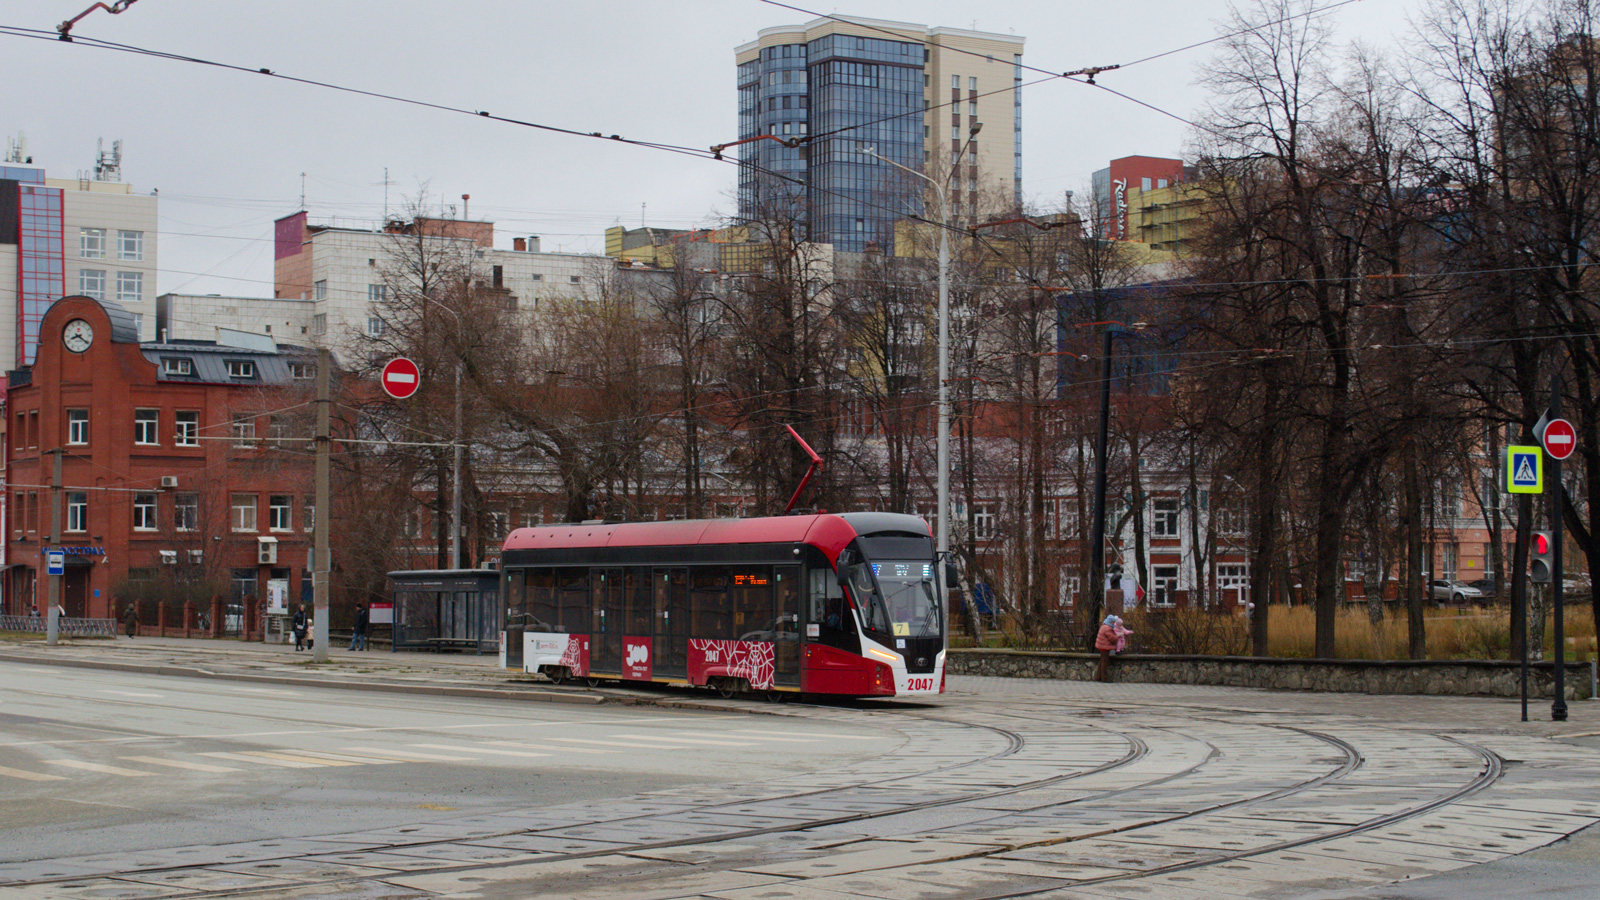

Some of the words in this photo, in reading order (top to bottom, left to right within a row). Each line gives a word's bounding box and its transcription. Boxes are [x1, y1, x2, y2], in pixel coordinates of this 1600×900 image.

[41, 546, 106, 555] ИОССТРАХ
[896, 624, 904, 634] 7
[626, 644, 648, 666] 300
[705, 650, 719, 662] 2047
[907, 678, 934, 691] 2047
